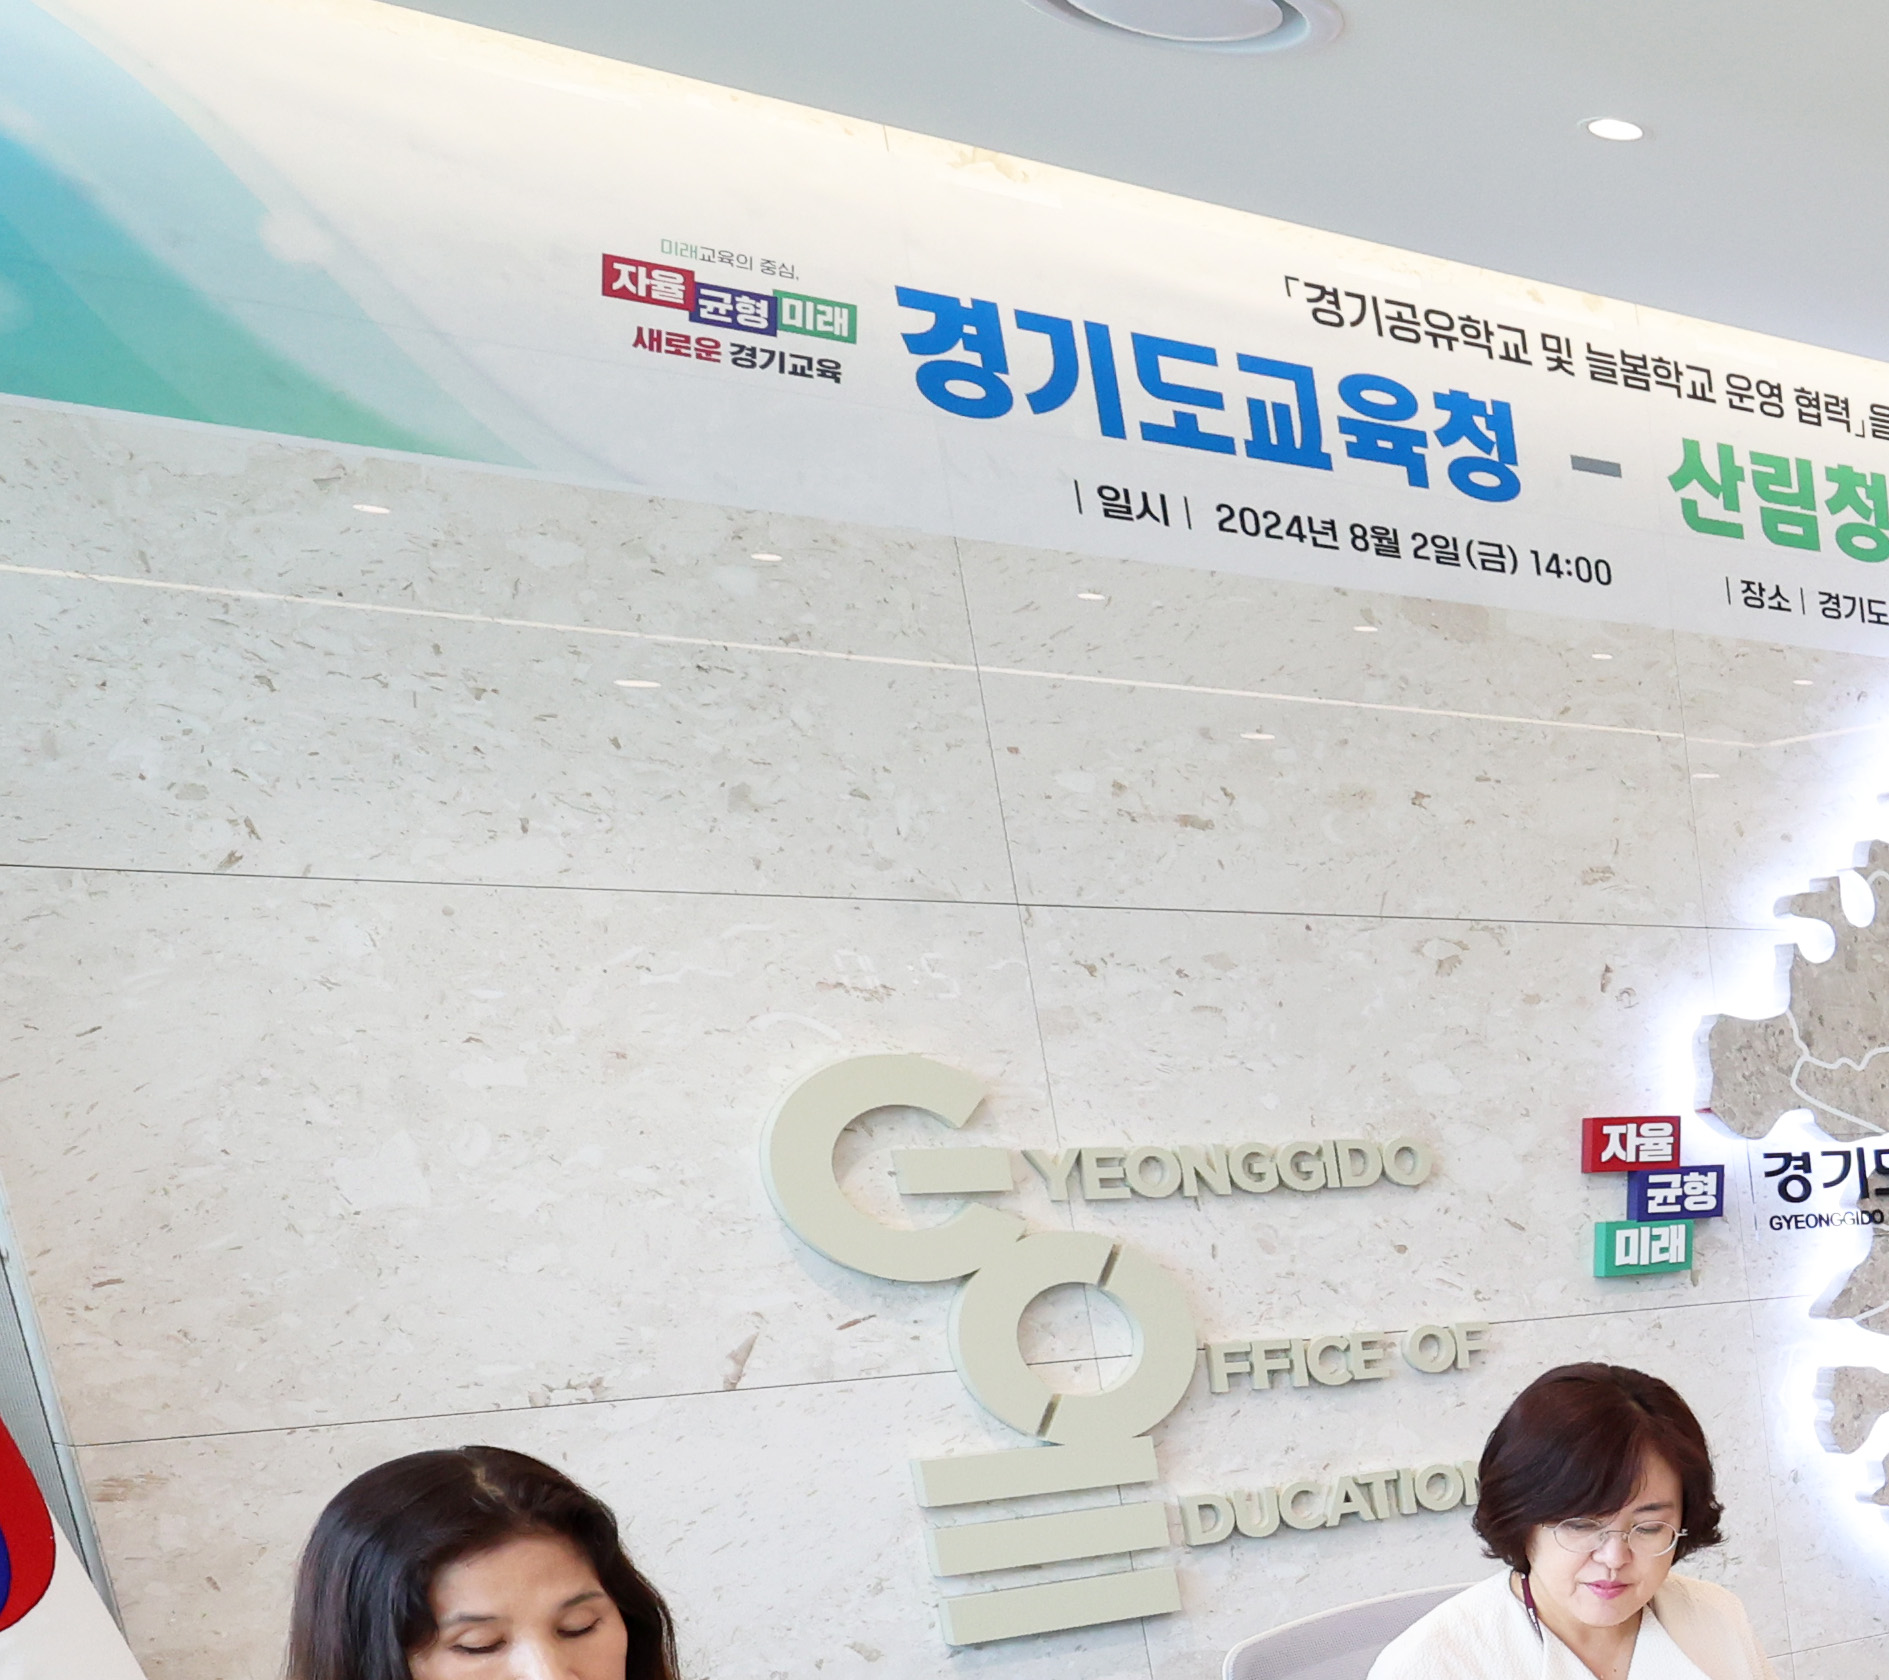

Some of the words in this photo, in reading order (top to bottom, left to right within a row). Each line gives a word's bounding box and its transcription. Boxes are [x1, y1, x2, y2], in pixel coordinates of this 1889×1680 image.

[660, 238, 754, 271] 미래교육의
[760, 257, 800, 281] 중심,
[611, 262, 686, 305] 자율
[697, 287, 770, 331] 균형
[780, 296, 850, 338] 미래
[632, 325, 722, 364] 새로운
[729, 341, 842, 385] 경기교육
[1284, 275, 1533, 367] 「경기공유학교
[1540, 332, 1576, 378] 및
[1585, 342, 1717, 404] 늘봄학교
[1725, 371, 1786, 420] 운영
[894, 285, 1522, 504] 경기도교육청
[1095, 484, 1171, 528] 일시
[1214, 502, 1341, 551] 2024년
[1350, 523, 1402, 560] 8월
[1411, 531, 1520, 577] 2일(금)
[1529, 548, 1614, 588] 14:00
[1740, 579, 1793, 614] 장소
[1600, 1121, 1676, 1164] 자율
[1645, 1171, 1719, 1213] 균형
[1769, 1208, 1885, 1232] GYEONGGIDO
[1613, 1223, 1687, 1268] 미래
[1401, 1321, 1491, 1374] OF
